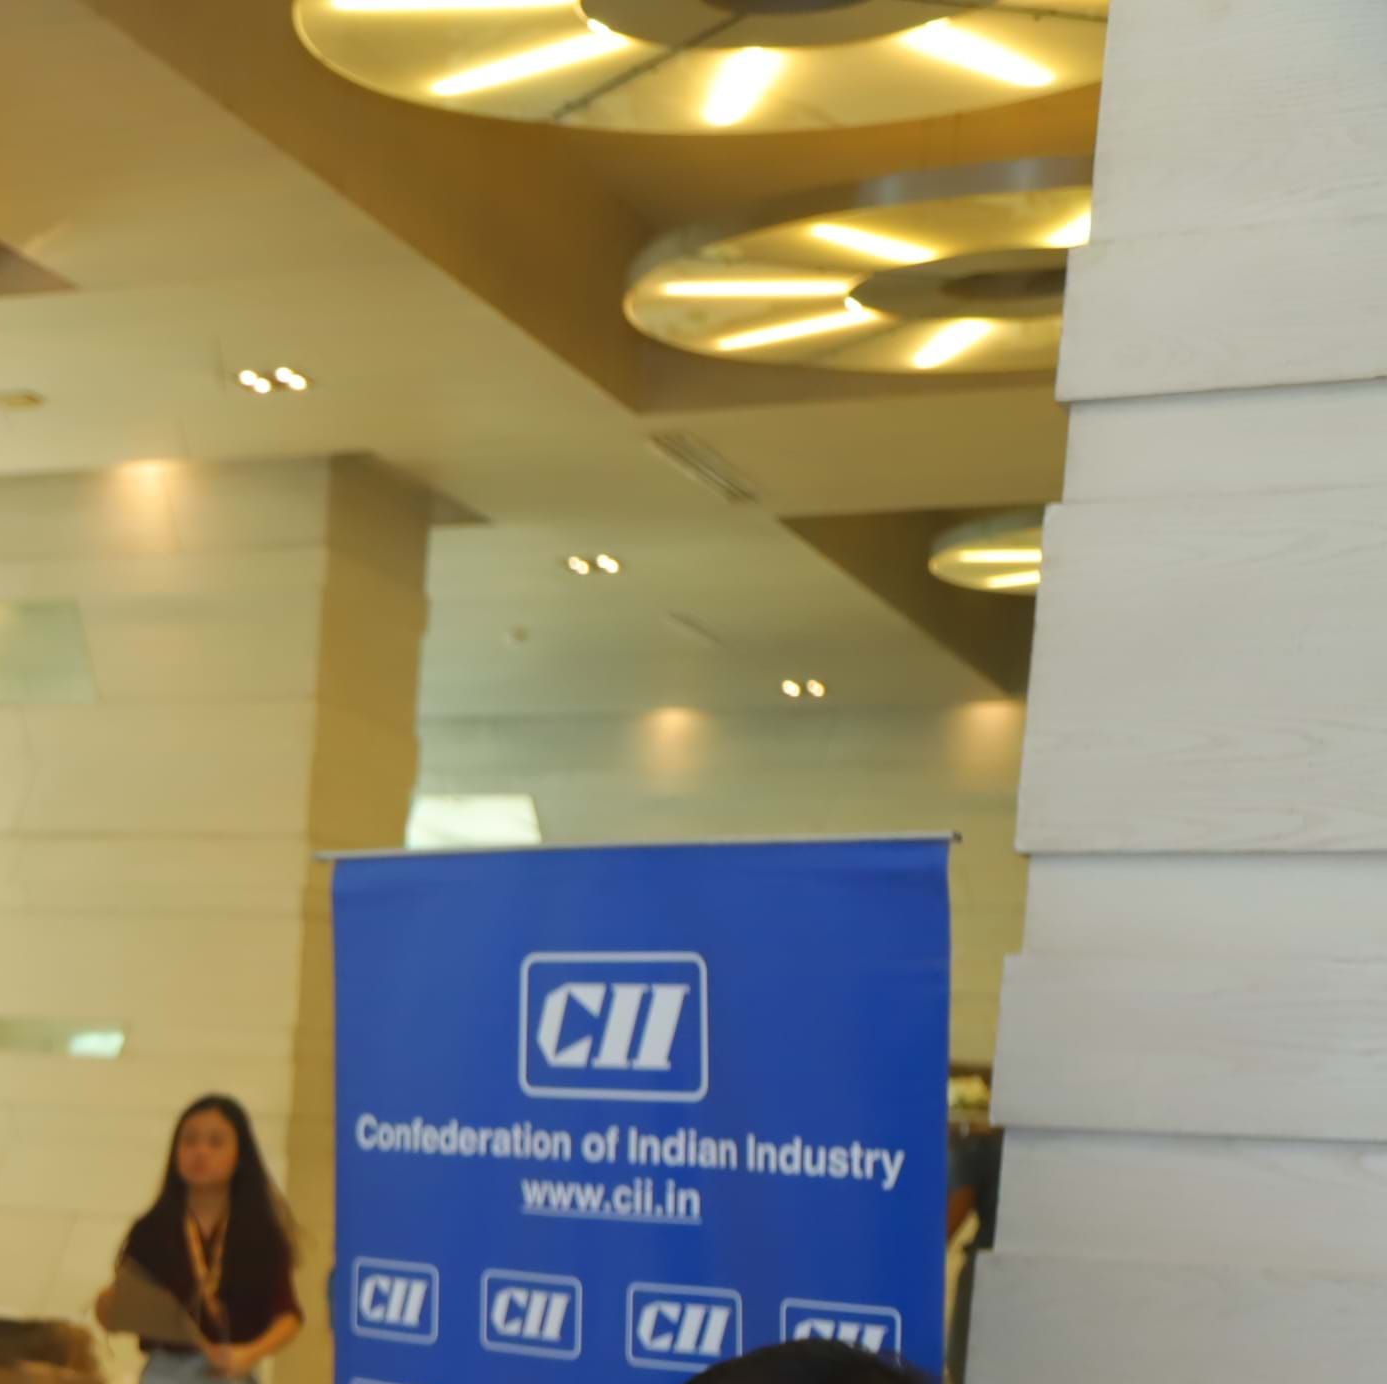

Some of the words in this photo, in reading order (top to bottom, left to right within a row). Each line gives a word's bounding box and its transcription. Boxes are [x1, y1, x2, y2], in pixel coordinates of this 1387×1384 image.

[537, 982, 691, 1071] CII
[355, 1114, 572, 1161] Confederation
[581, 1125, 619, 1163] of
[628, 1127, 738, 1170] Indian
[746, 1133, 906, 1190] Industry
[521, 1178, 702, 1221] www.cii.in
[359, 1274, 429, 1328] CII
[491, 1287, 571, 1342] CII
[637, 1300, 732, 1357] CII
